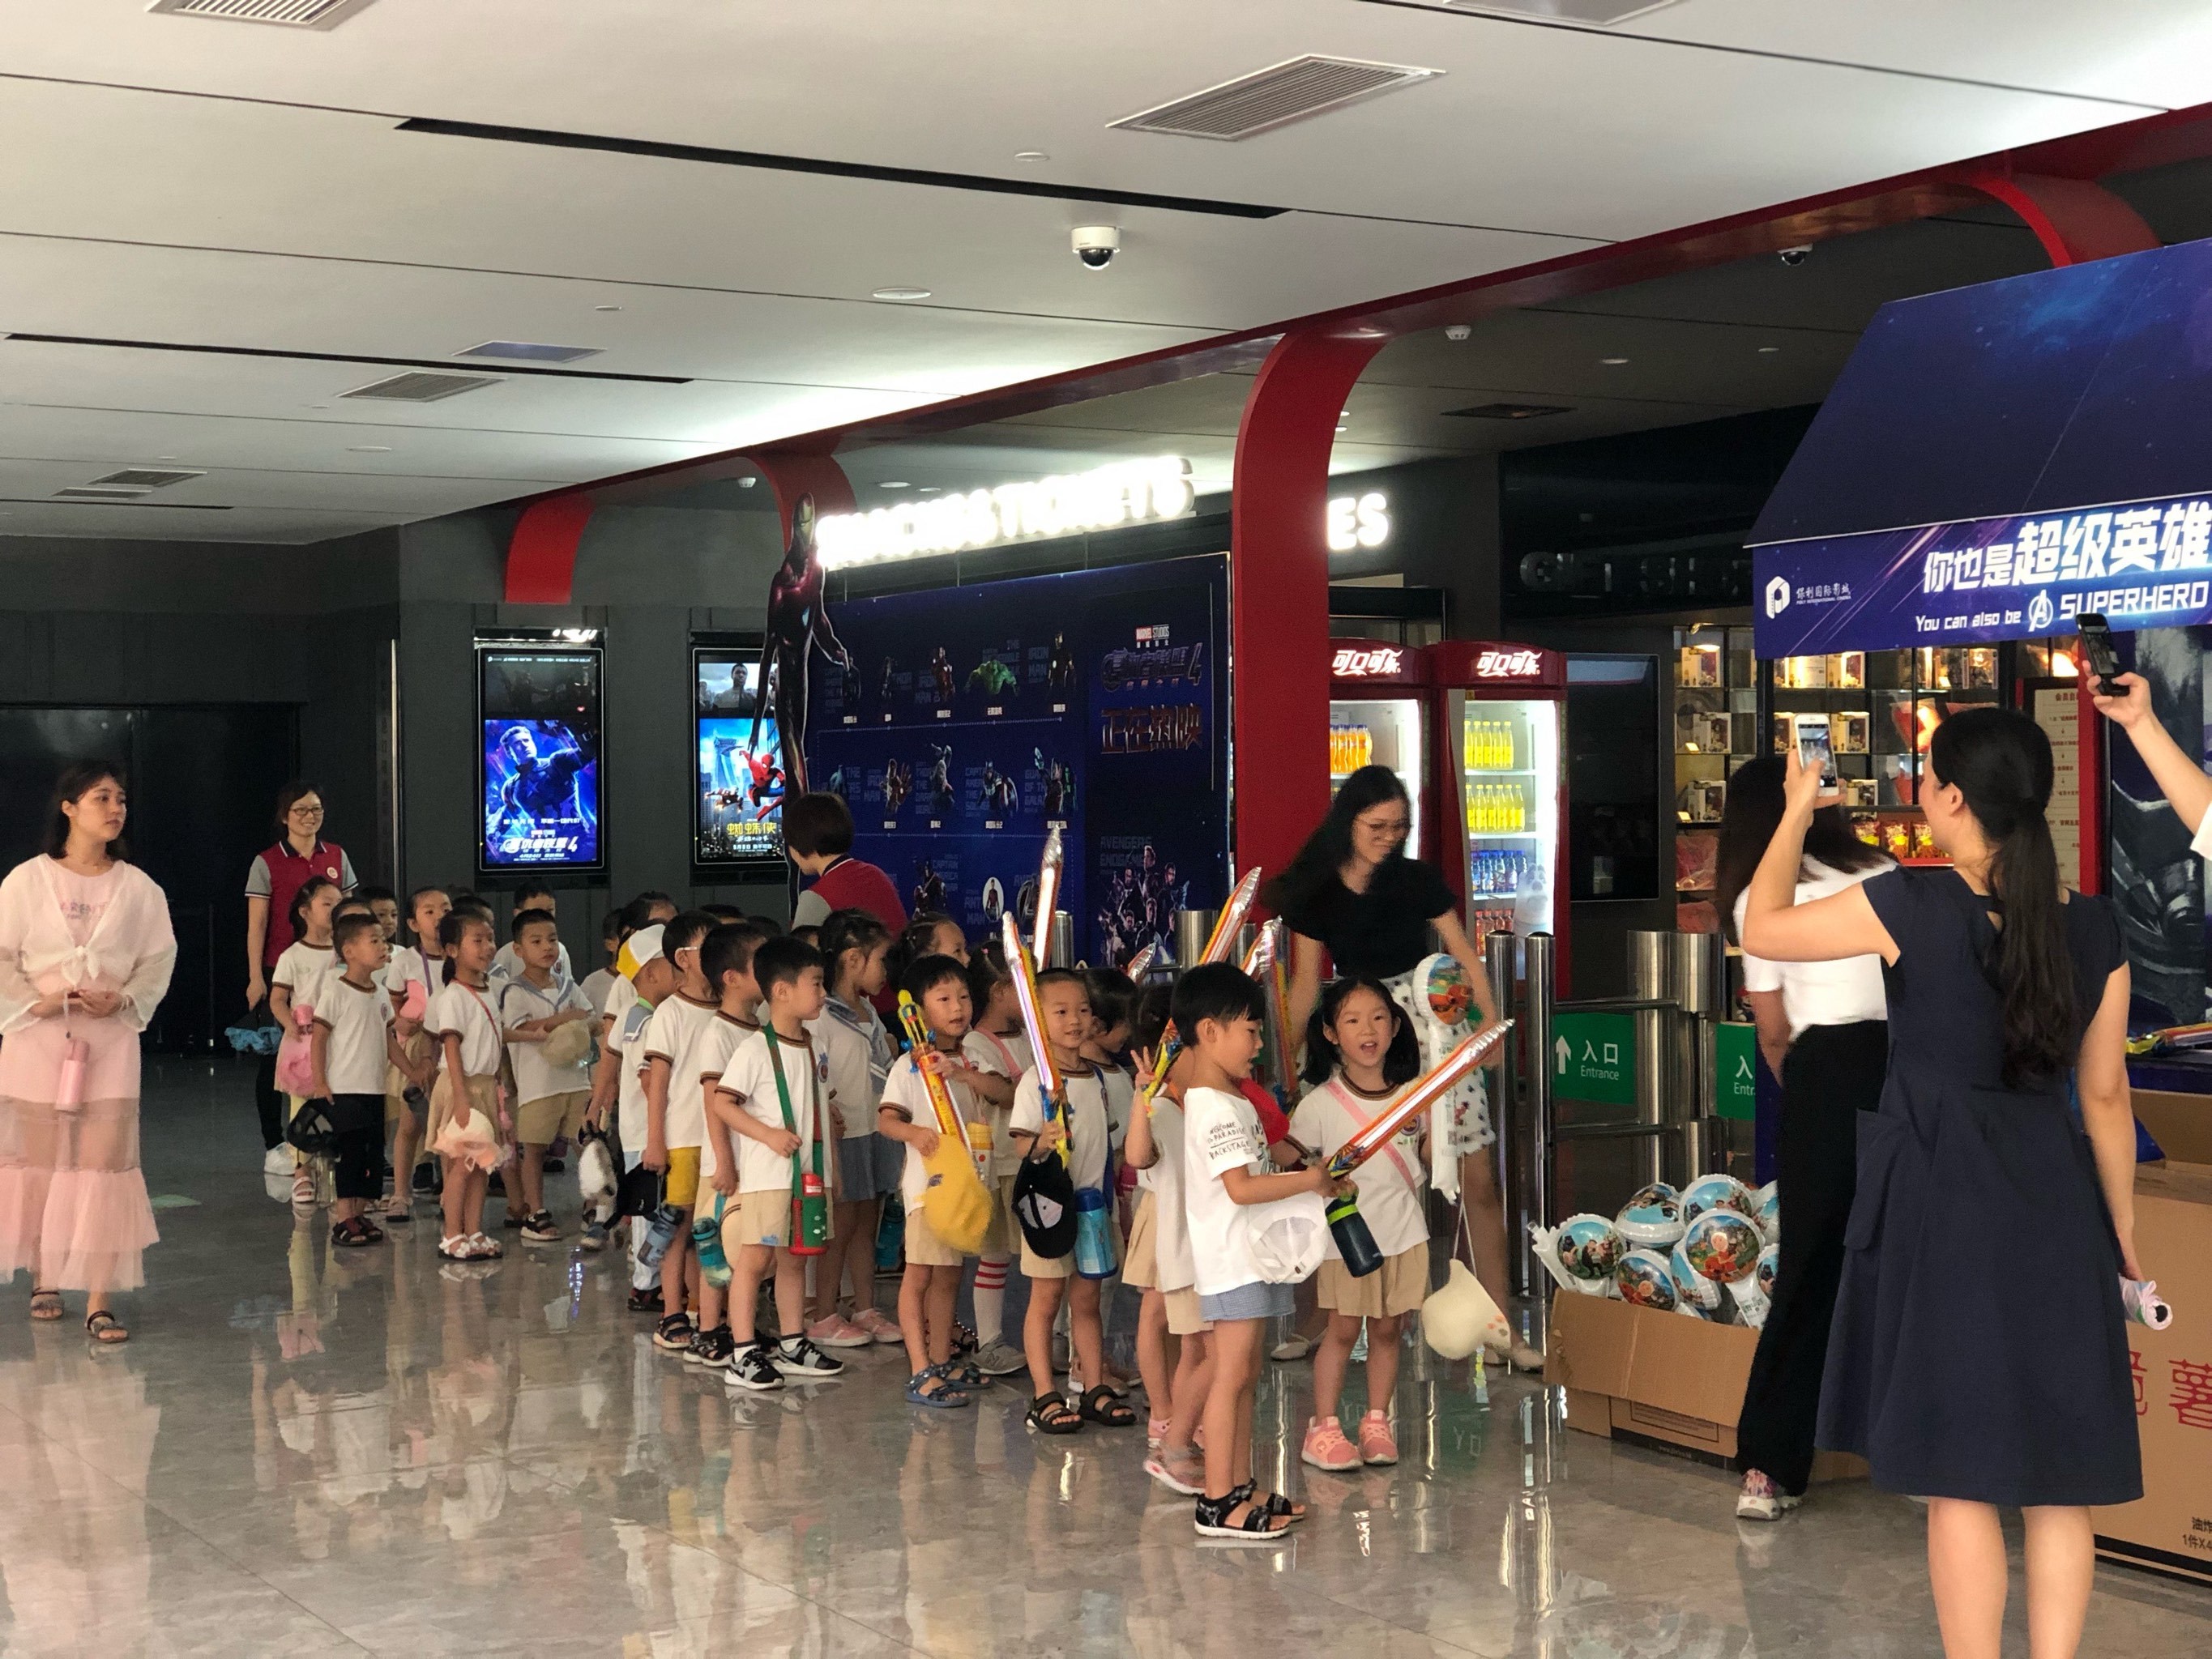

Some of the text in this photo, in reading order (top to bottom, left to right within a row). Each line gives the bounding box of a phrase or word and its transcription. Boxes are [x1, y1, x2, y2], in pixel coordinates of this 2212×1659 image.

[1924, 501, 2212, 594] 你也是超级英雄
[1796, 582, 1851, 599] 保利国际影城
[1915, 615, 1940, 633] You
[1944, 618, 1967, 629] can
[1972, 612, 1999, 627] also
[2005, 609, 2022, 625] be
[2060, 581, 2210, 621] SUPERHERO
[1332, 648, 1403, 676] 可口可乐
[1476, 650, 1543, 677] 可口可乐
[727, 822, 777, 835] 蜘蛛侠
[1582, 1039, 1619, 1065] 入口
[1580, 1065, 1620, 1081] Entrance
[1736, 1055, 1754, 1081] 入
[1733, 1082, 1755, 1096] Entr
